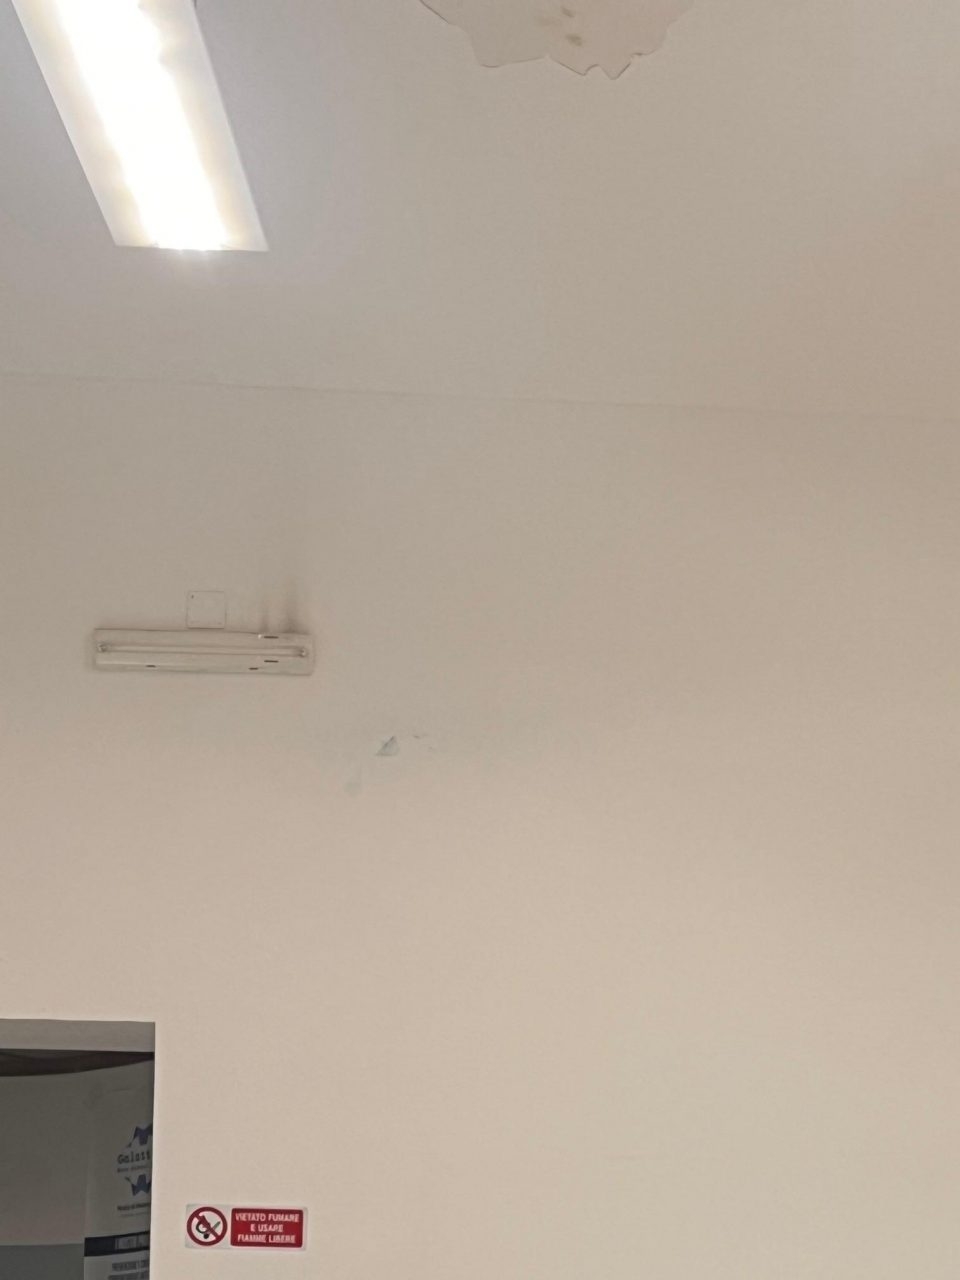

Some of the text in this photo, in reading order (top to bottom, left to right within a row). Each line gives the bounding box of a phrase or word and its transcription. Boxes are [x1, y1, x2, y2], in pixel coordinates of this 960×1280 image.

[235, 1212, 299, 1222] VIETATO FUMARE
[257, 1224, 283, 1232] USARE
[237, 1234, 296, 1243] FIAMME LIBERE
